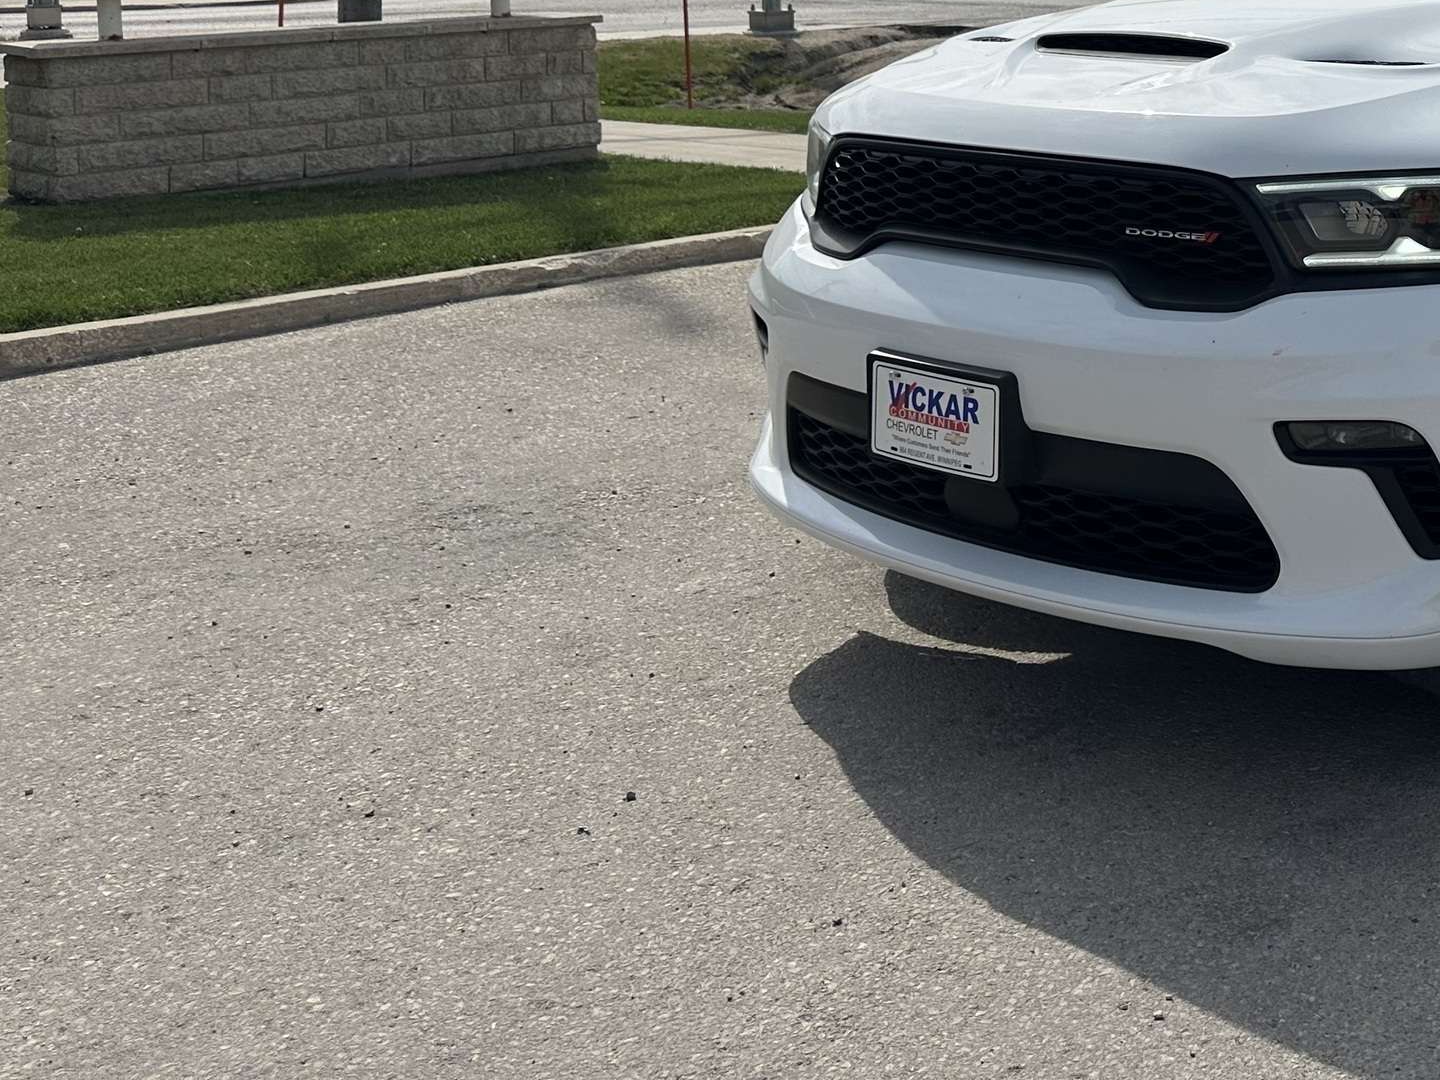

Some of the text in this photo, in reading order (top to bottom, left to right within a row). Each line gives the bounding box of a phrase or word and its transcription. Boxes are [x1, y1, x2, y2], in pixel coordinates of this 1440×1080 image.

[1125, 226, 1206, 241] DODGE
[888, 379, 980, 425] VICKAR
[886, 417, 939, 440] CHEVROLET
[889, 405, 970, 434] COMMUNITY
